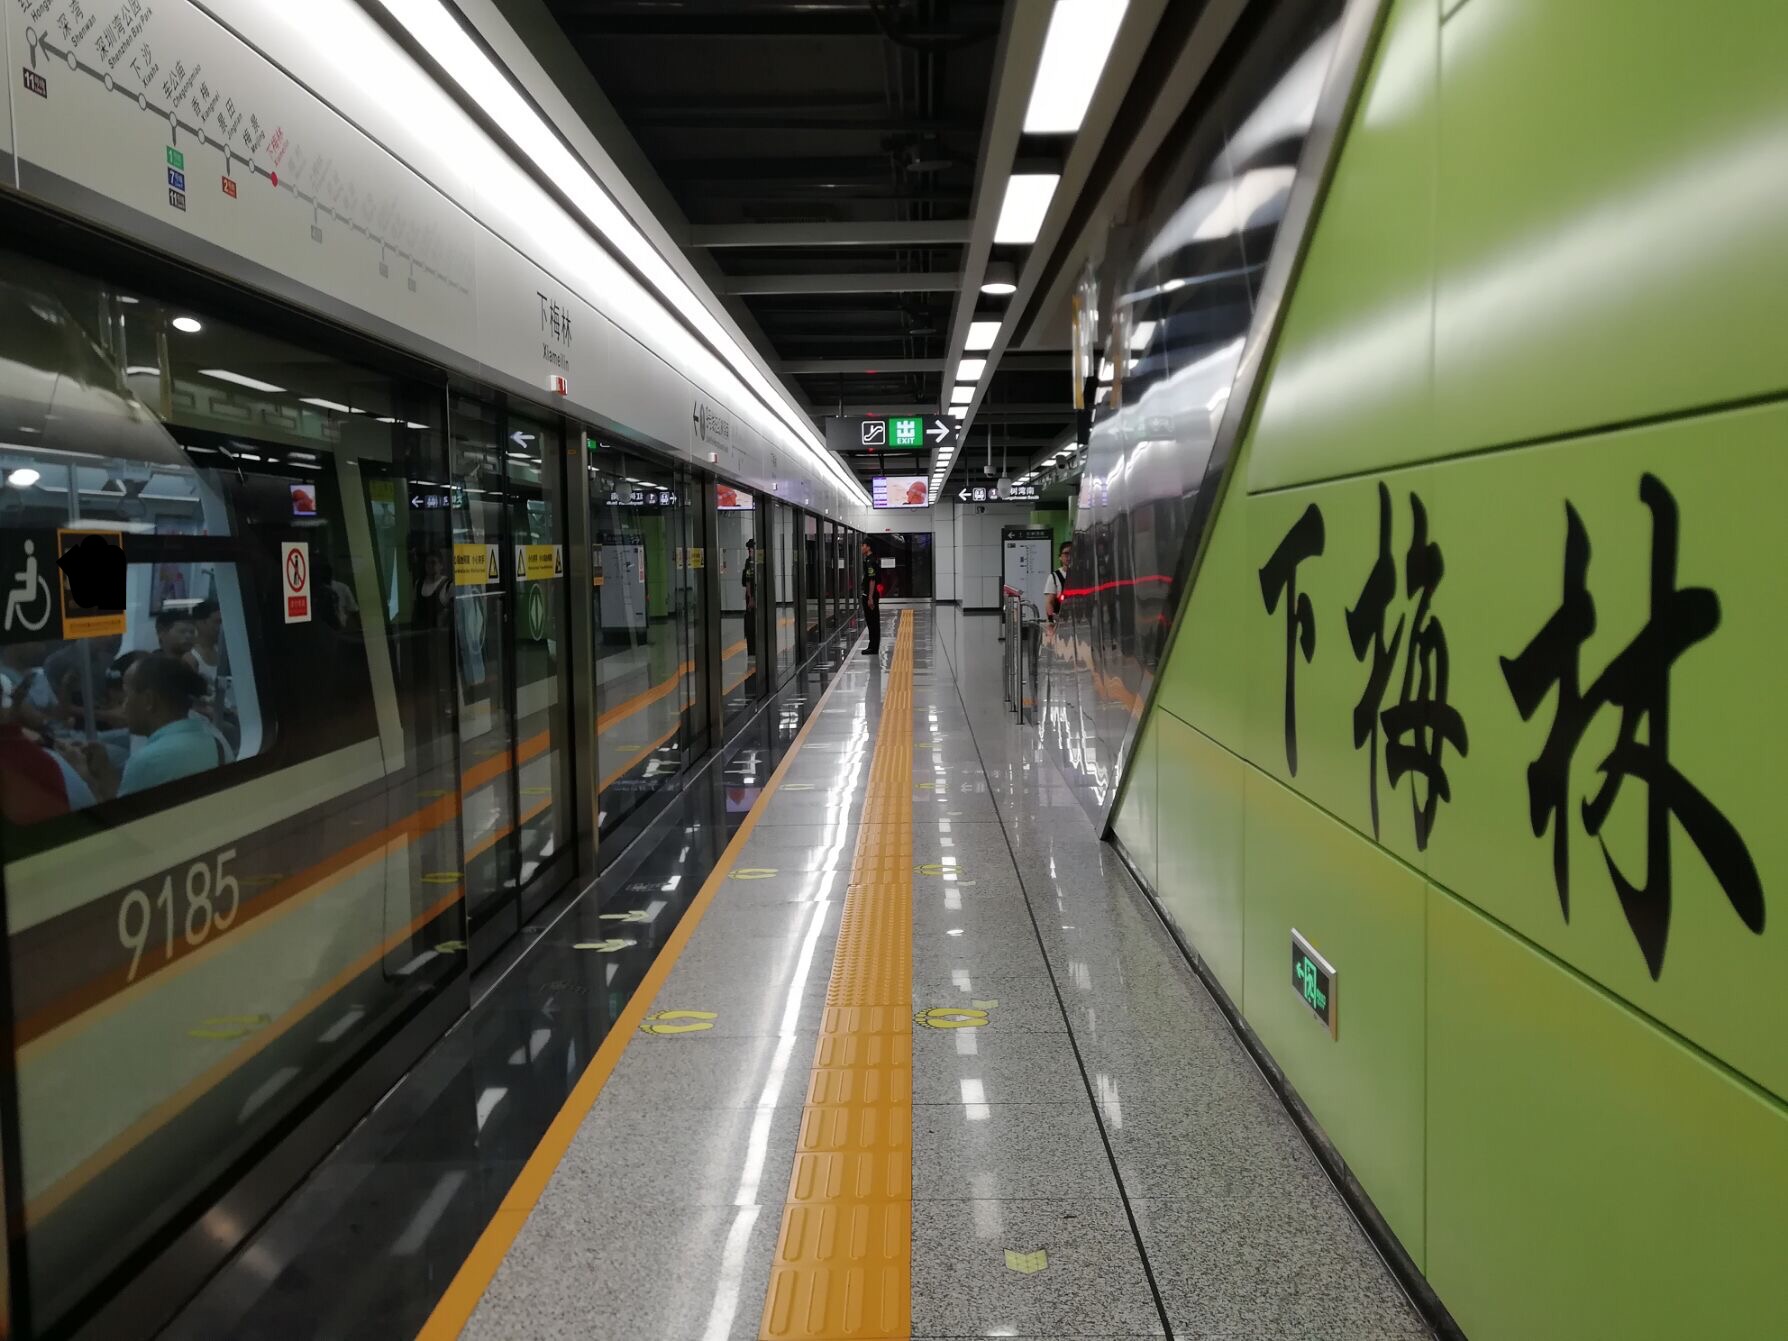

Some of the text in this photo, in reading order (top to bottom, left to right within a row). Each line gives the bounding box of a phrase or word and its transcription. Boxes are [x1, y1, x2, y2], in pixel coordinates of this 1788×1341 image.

[71, 14, 97, 48] Shenwan
[107, 34, 136, 70] Shenzhen
[130, 21, 144, 37] Bay
[129, 42, 152, 79] 下沙
[142, 63, 159, 89] Xiasha
[162, 60, 186, 100] 车公庙
[536, 291, 572, 347] 下梅林
[542, 342, 570, 371] Xiameilin
[897, 437, 915, 445] EXIT
[1009, 486, 1035, 495] 树湾南
[1259, 472, 1766, 982] 下梅林
[118, 848, 239, 981] 9185
